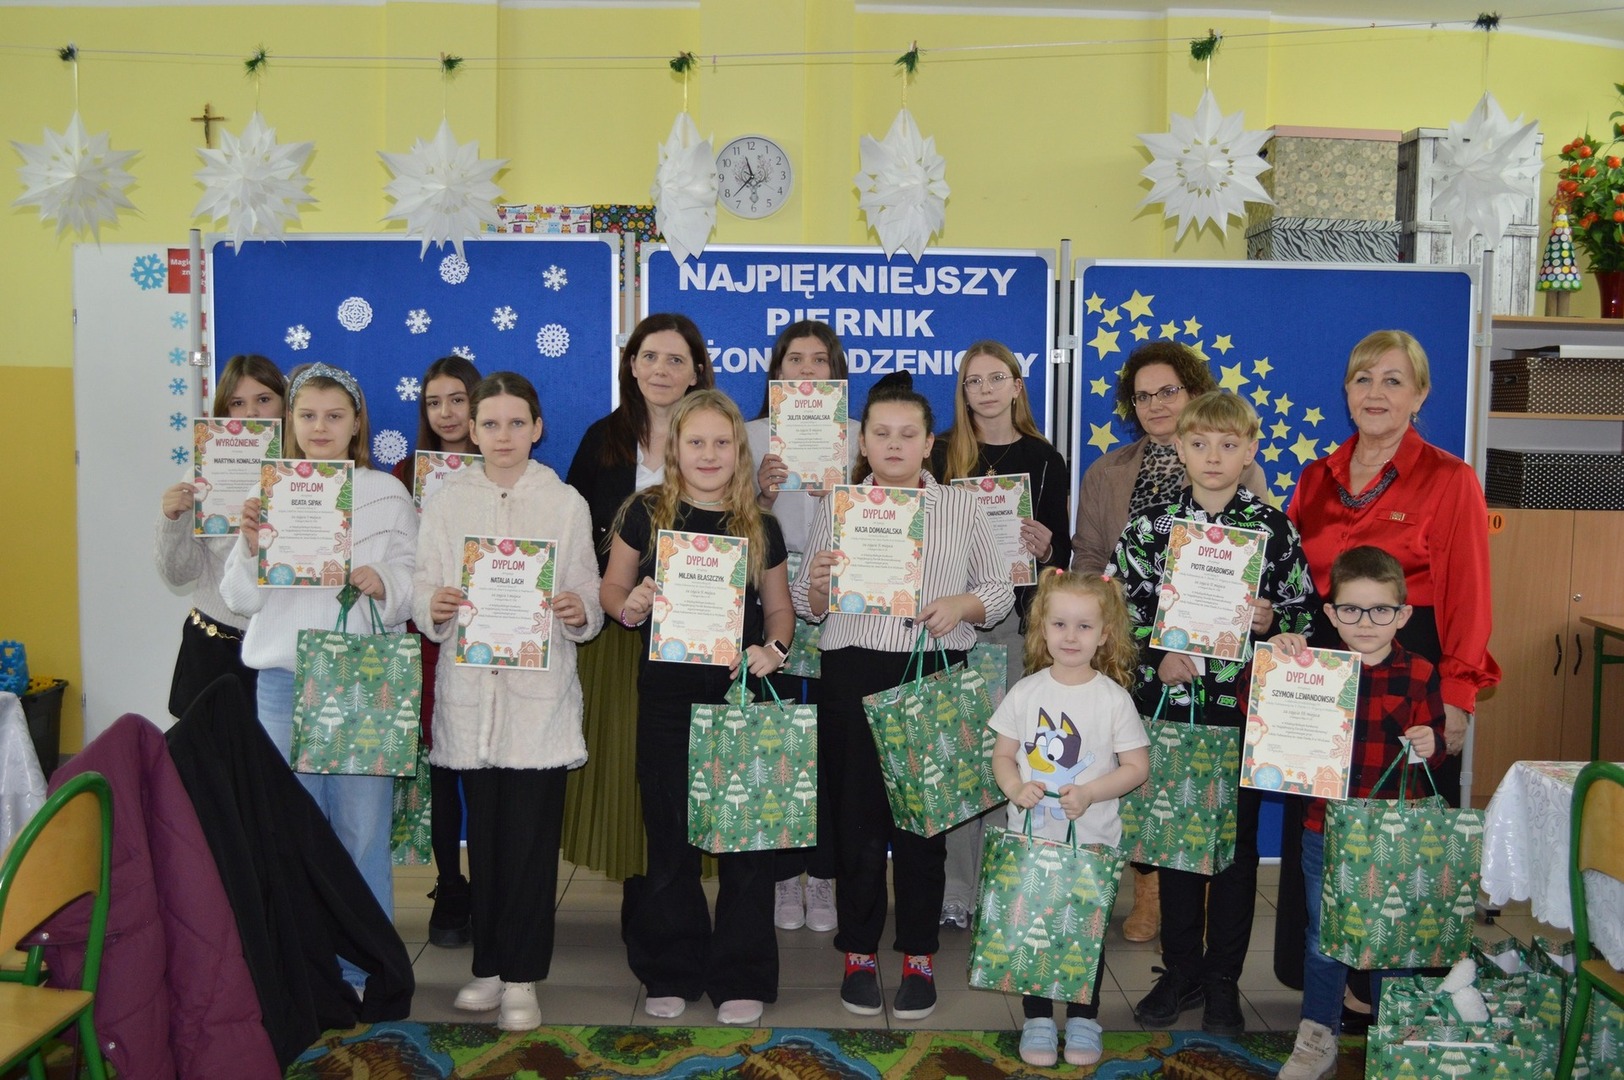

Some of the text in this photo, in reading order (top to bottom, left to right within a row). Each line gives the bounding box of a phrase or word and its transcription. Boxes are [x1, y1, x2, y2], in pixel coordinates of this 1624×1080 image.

[732, 146, 740, 155] 11
[746, 142, 755, 151] 12
[765, 146, 769, 154] 1
[722, 158, 731, 168] 10
[776, 156, 782, 165] 2
[718, 174, 725, 183] 9
[781, 172, 786, 180] 3
[724, 188, 731, 198] 8
[777, 186, 783, 195] 4
[735, 200, 742, 209] 7
[766, 198, 772, 208] 5
[750, 204, 757, 213] 6
[679, 263, 1018, 300] NAJPIĘKNIEJSZY
[795, 400, 822, 408] DYPLOM
[216, 437, 259, 447] WYRÓŻNIENIE
[291, 482, 323, 492] DYPLOM
[863, 509, 895, 520] DYPLOM
[869, 527, 902, 535] DOMAGALSKA
[1198, 546, 1232, 560] DYPLOM
[492, 560, 525, 570] DYPLOM
[687, 555, 719, 567] DYPLOM
[1206, 566, 1234, 576] GRABOWSKI
[679, 572, 724, 582] MILENA BŁASZCZYK
[1286, 671, 1324, 686] DYPLOM
[1272, 690, 1335, 703] SZYMON LEWANDOWSKI
